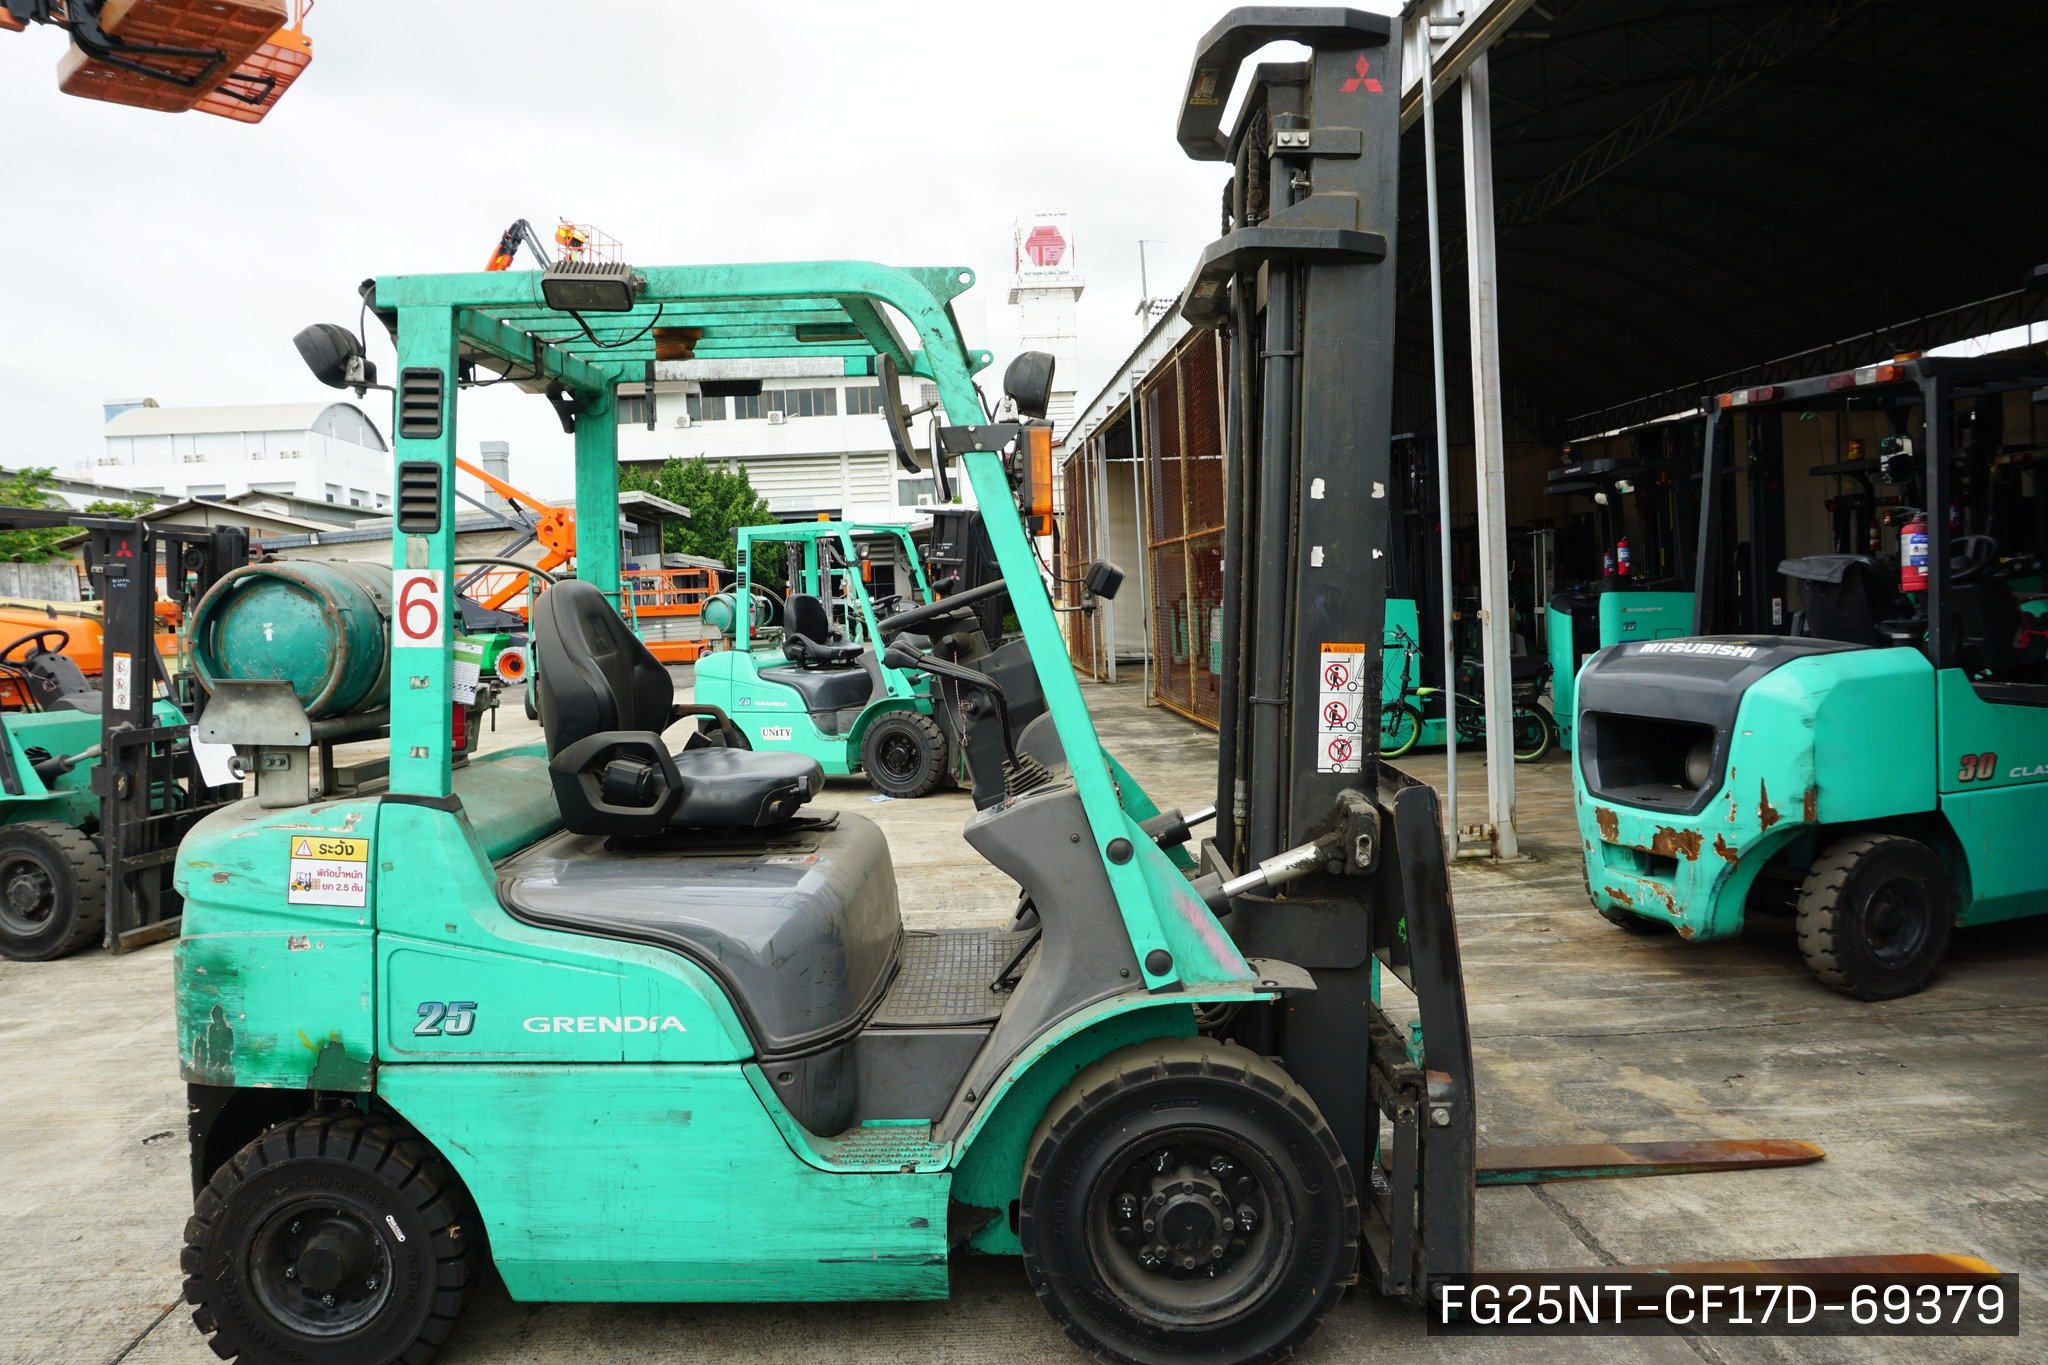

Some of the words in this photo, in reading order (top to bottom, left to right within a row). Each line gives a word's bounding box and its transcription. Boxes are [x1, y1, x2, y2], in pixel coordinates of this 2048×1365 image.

[398, 576, 438, 640] 6
[1639, 642, 1758, 658] MITSUBISHI
[1958, 752, 1997, 783] 30
[318, 840, 355, 856] ระวัง
[316, 866, 363, 879] พิกัดน้ำหนัก
[335, 883, 350, 892] 2.5
[413, 1001, 477, 1036] 25
